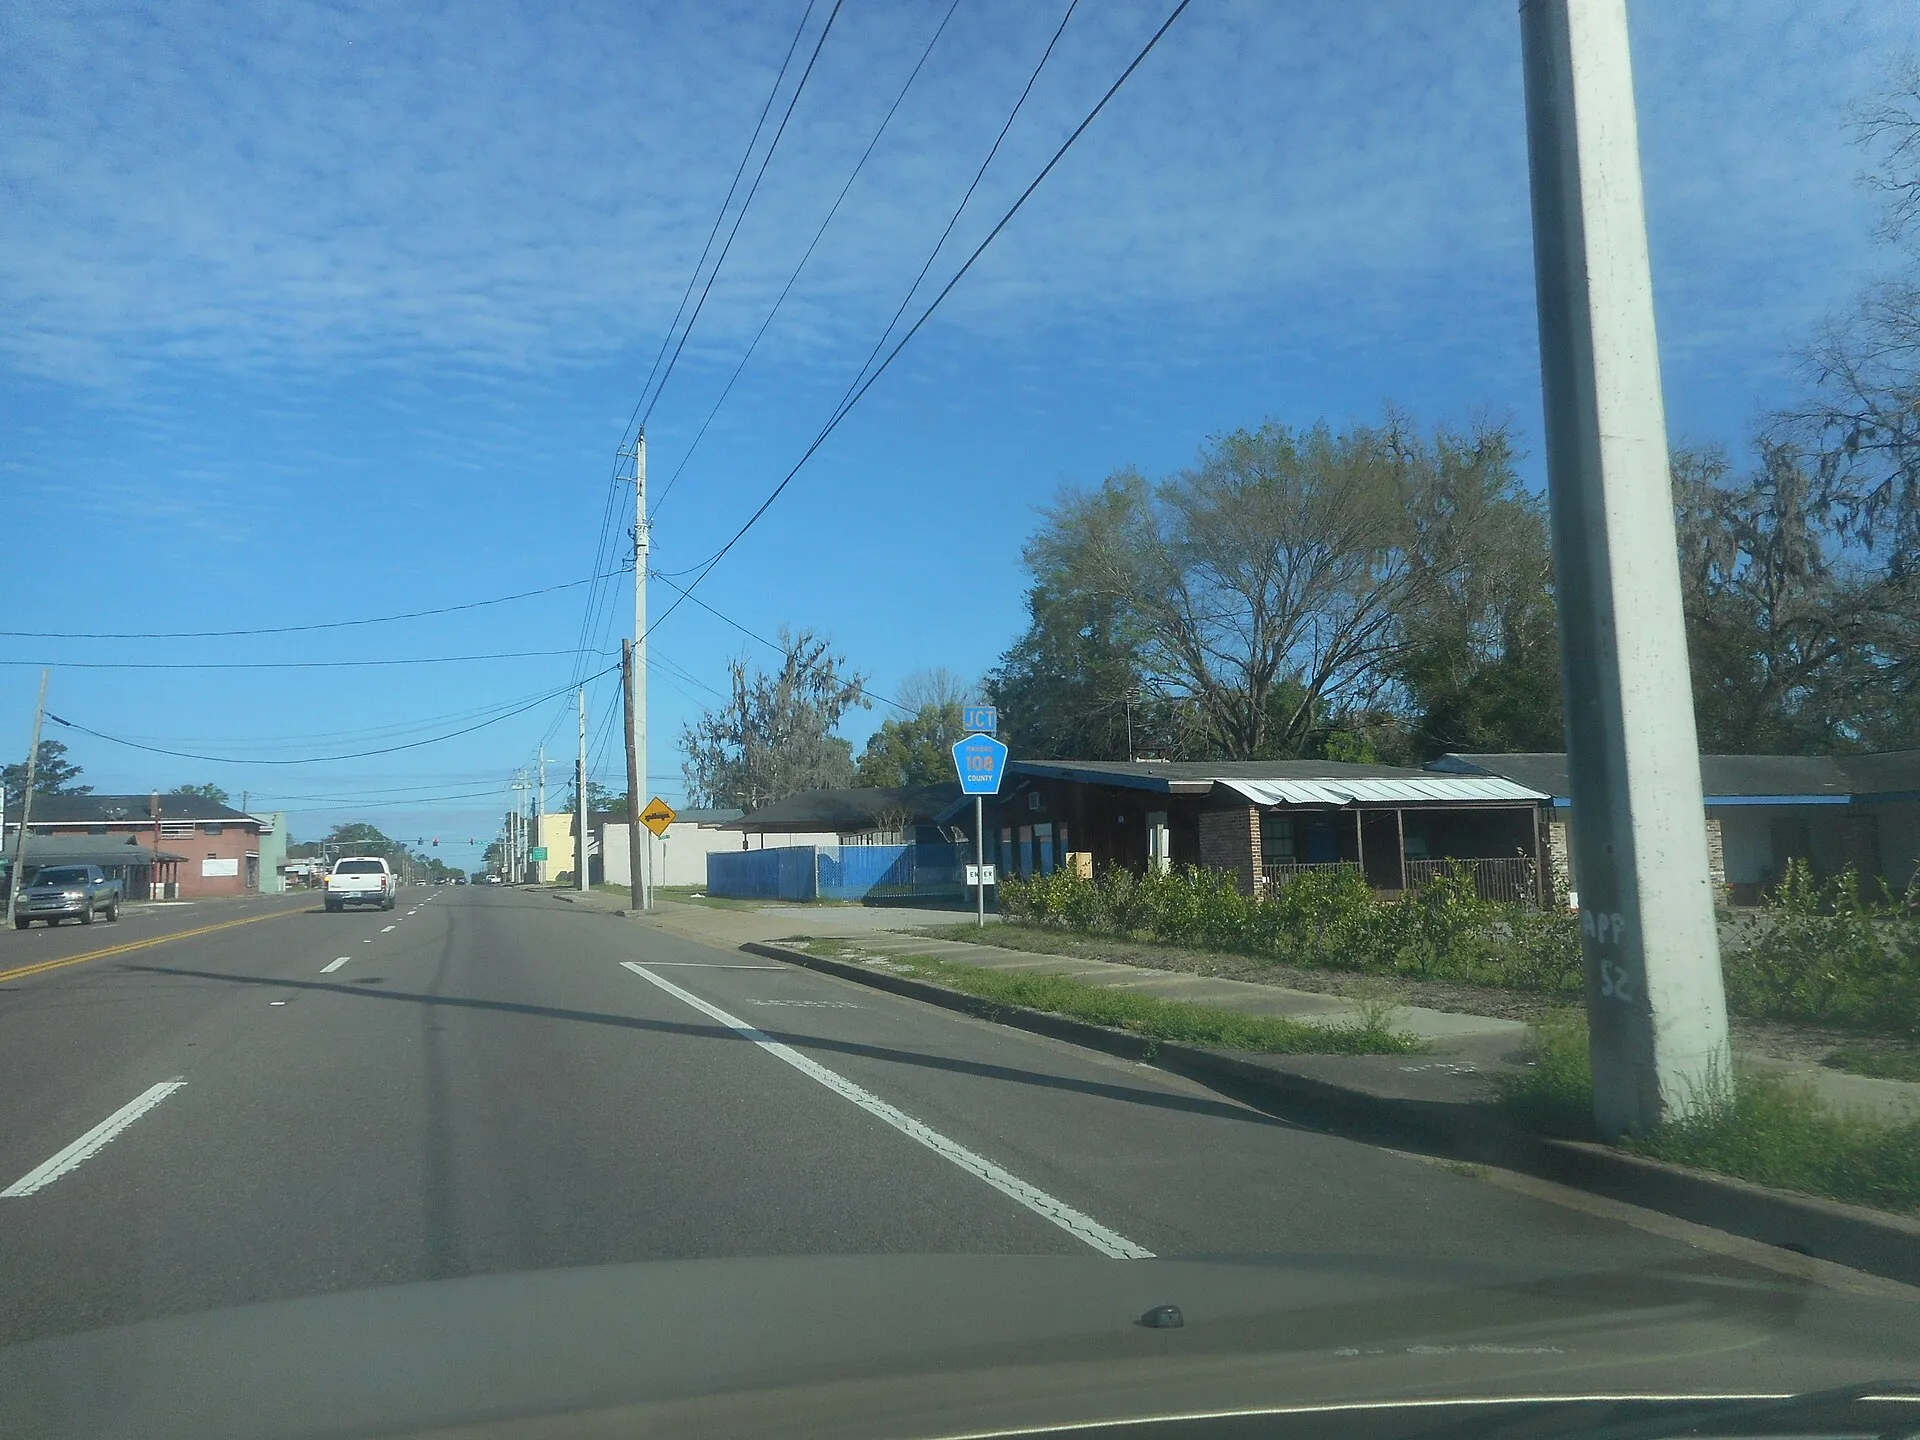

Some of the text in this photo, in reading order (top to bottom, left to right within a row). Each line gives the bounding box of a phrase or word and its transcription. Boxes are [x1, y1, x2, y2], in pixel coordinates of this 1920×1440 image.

[965, 710, 993, 727] JCT
[966, 756, 994, 771] 108
[967, 774, 993, 782] COUNTY
